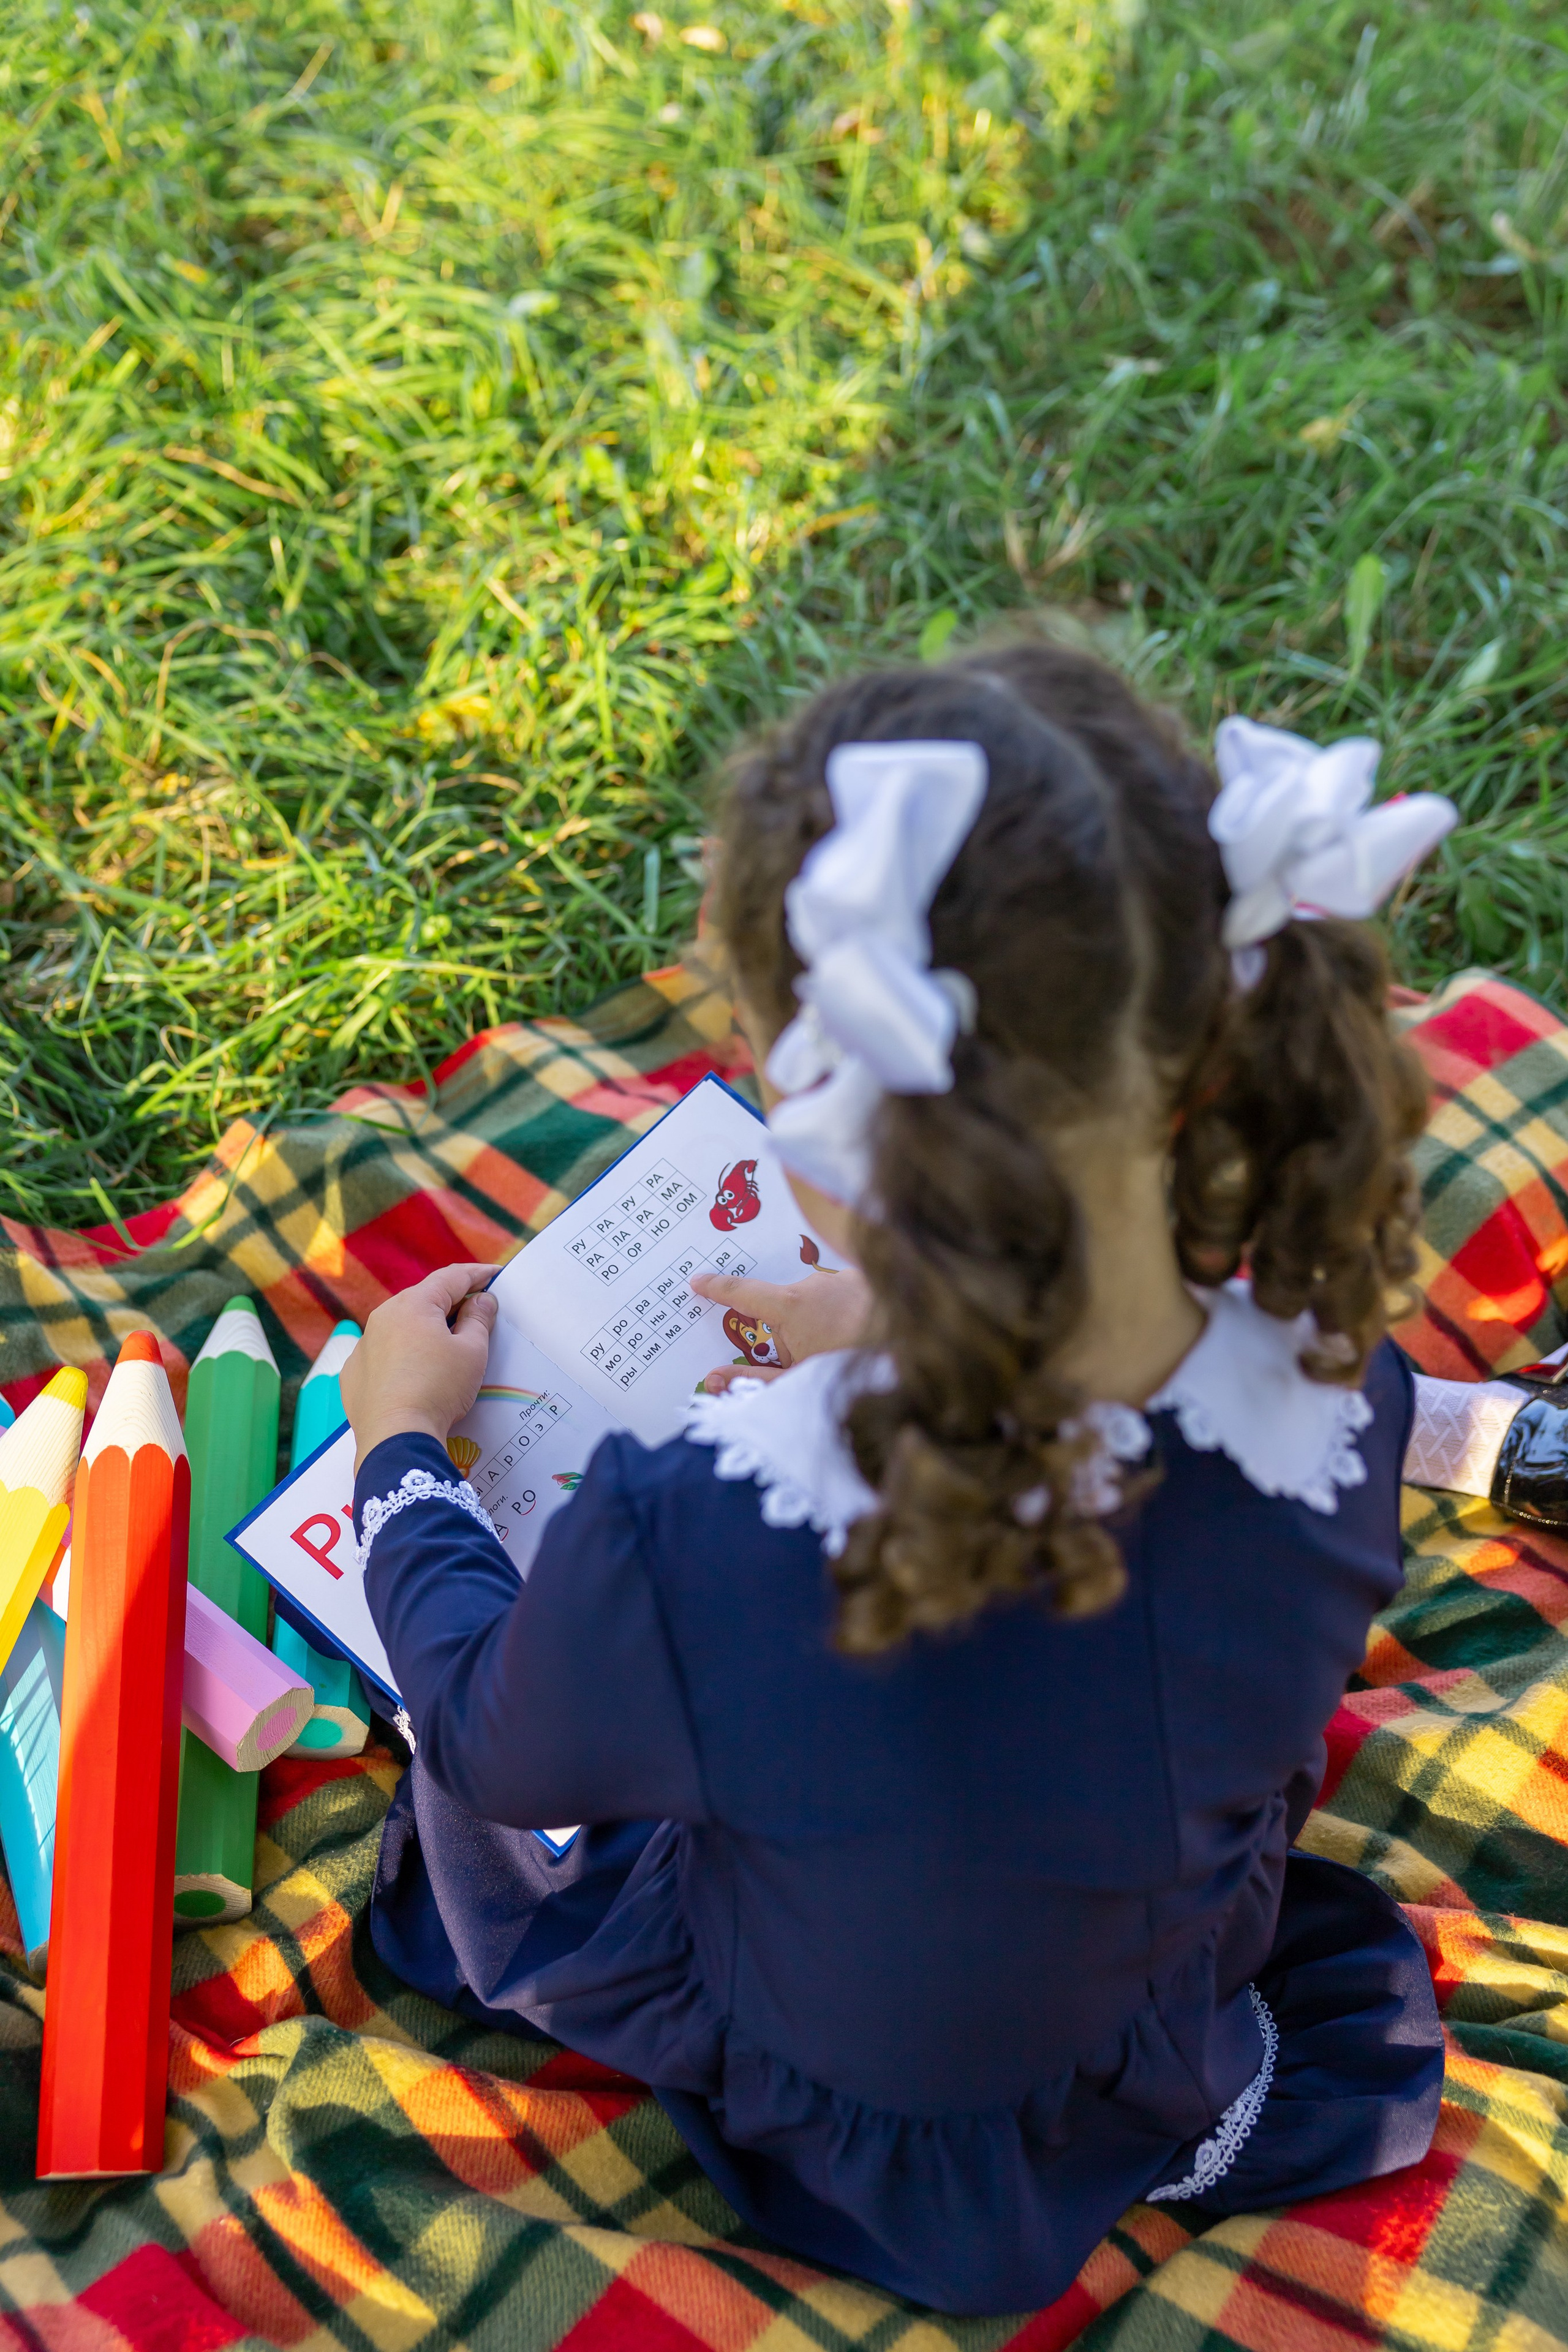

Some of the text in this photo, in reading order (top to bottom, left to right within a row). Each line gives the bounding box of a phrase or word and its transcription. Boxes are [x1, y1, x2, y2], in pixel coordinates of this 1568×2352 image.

[571, 1174, 664, 1254] РУ РА РУ РА
[586, 1182, 683, 1267] РА ЛА РА МА
[601, 1192, 698, 1281] РО ОР НО ОМ
[589, 1261, 693, 1360] ру ро ра ры рэ
[605, 1251, 731, 1372] мо ро ны ры ра
[619, 1366, 638, 1387] ры
[642, 1343, 662, 1361] ым
[665, 1324, 682, 1340] ма
[687, 1306, 702, 1319] ар
[519, 1390, 550, 1421] Прочти:
[487, 1494, 508, 1517] логи.
[488, 1471, 500, 1482] А
[494, 1490, 535, 1537] А РО
[290, 1500, 354, 1580] Р
